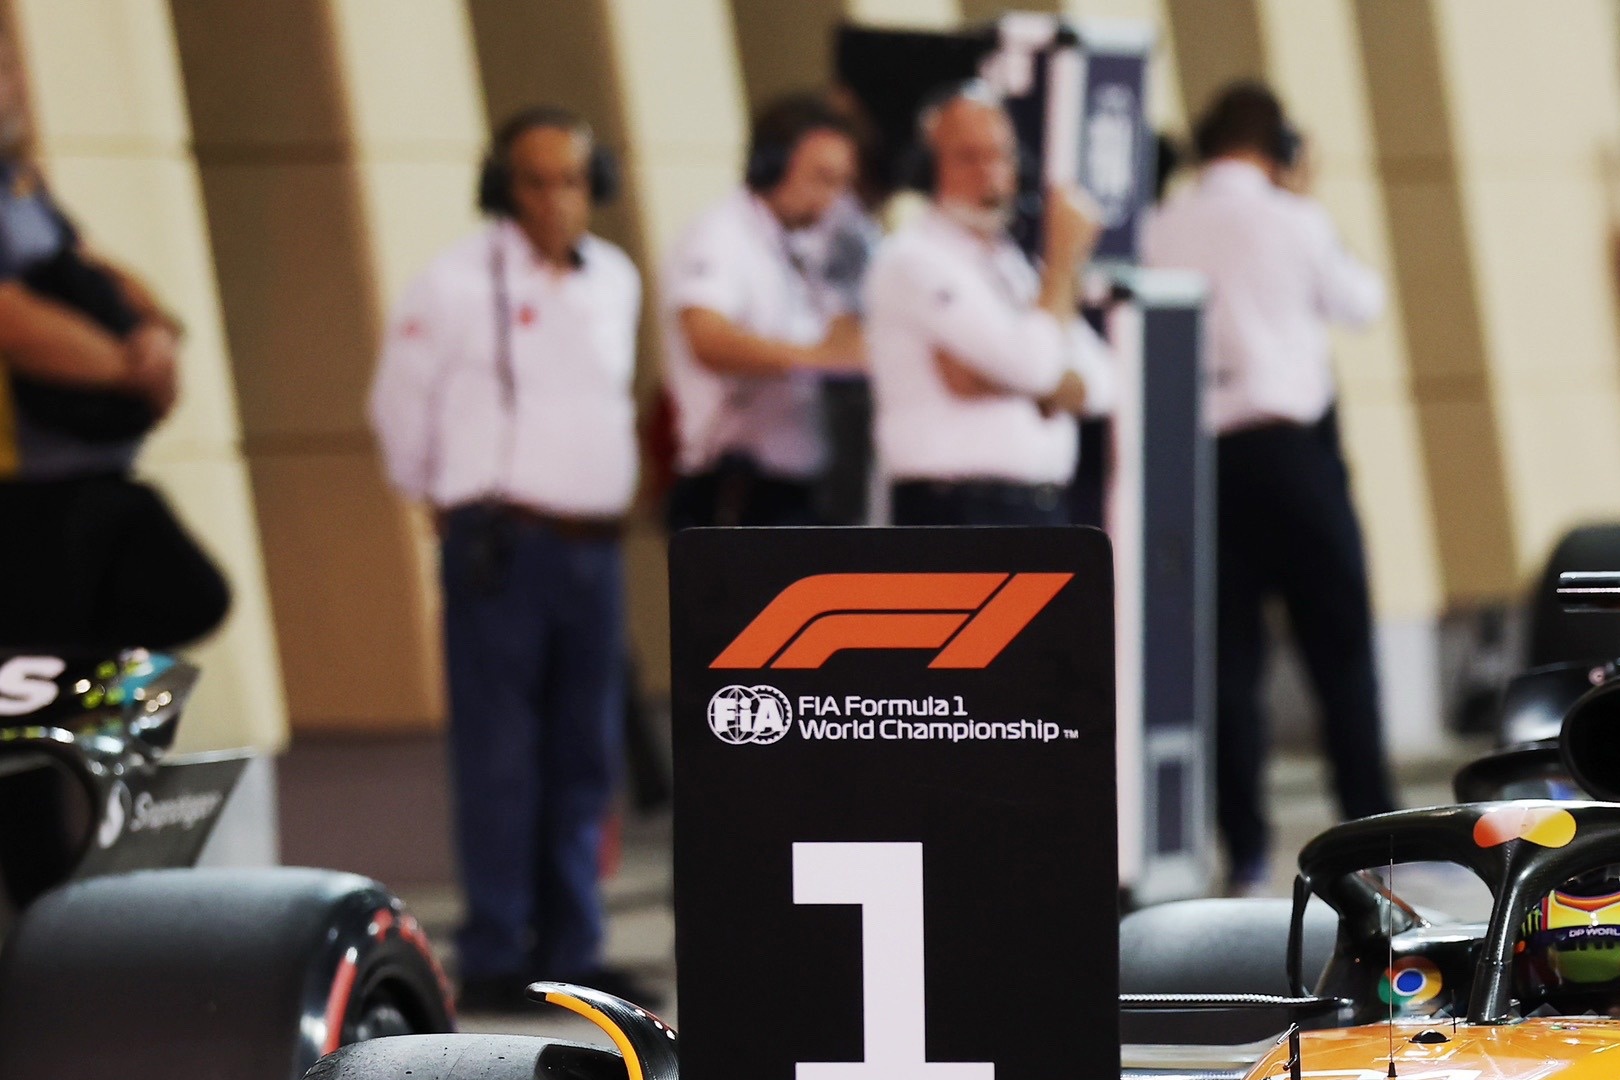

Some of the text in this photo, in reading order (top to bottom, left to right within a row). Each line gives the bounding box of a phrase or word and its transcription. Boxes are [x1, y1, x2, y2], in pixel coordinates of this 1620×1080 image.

[798, 695, 969, 716] FIA Formula 1
[798, 719, 875, 740] World
[879, 719, 1060, 743] Championship
[1568, 929, 1585, 938] DP
